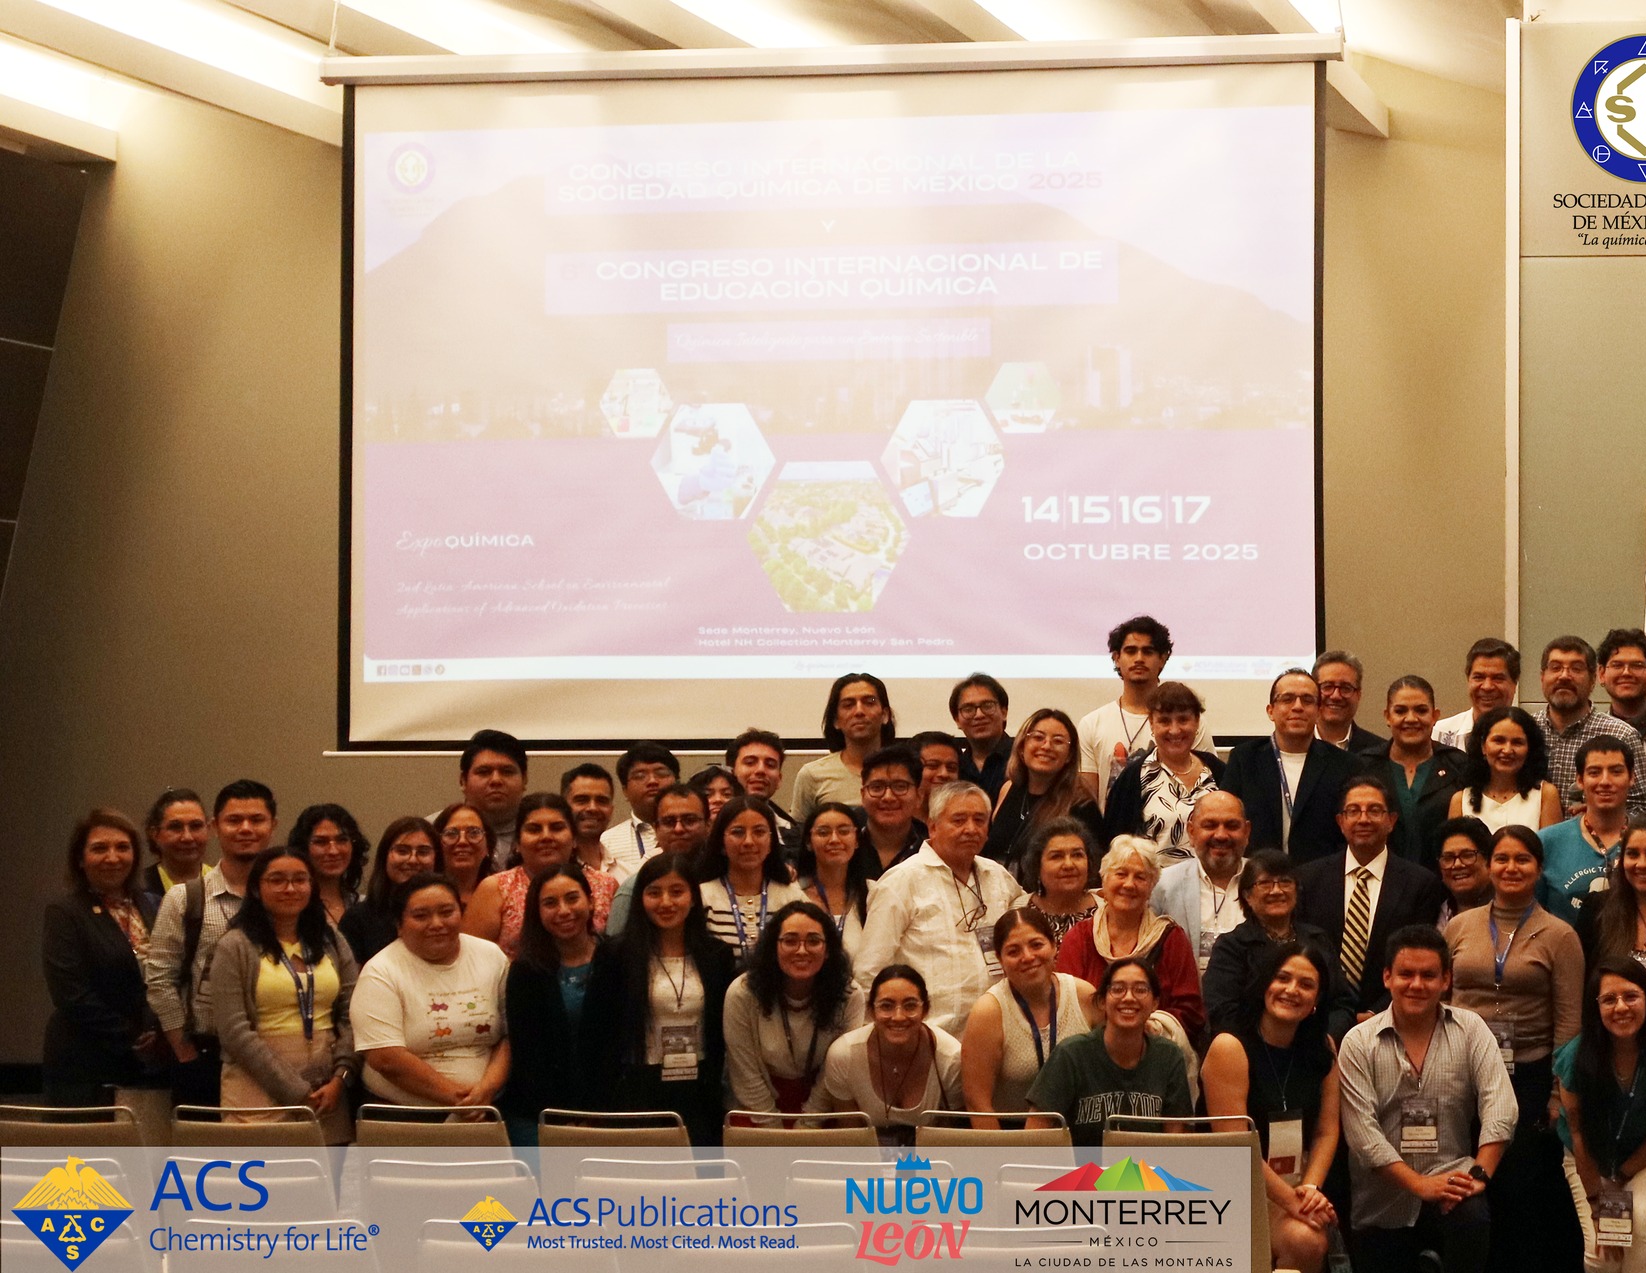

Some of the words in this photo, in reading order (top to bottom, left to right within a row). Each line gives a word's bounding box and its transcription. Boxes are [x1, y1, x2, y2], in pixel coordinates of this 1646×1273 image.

[569, 160, 733, 181] CONGRESO
[743, 154, 984, 177] INTERNACIONAL
[995, 152, 1034, 170] DE
[1044, 151, 1081, 168] LA
[558, 182, 712, 201] SOCIEDAD
[854, 177, 892, 194] DE
[1028, 171, 1104, 190] 2025
[821, 219, 836, 233] Y
[596, 258, 774, 280] CONGRESO
[785, 253, 1048, 276] INTERNACIONAL
[1059, 251, 1104, 270] DE
[661, 275, 849, 301] EDUCACIÓN
[860, 273, 999, 300] QUÍMICA
[1023, 543, 1171, 561] OCTUBRE
[1183, 543, 1259, 560] 2025
[1564, 867, 1597, 889] ALLERGIC
[1076, 1091, 1125, 1125] NEW
[1128, 1092, 1163, 1118] YOR
